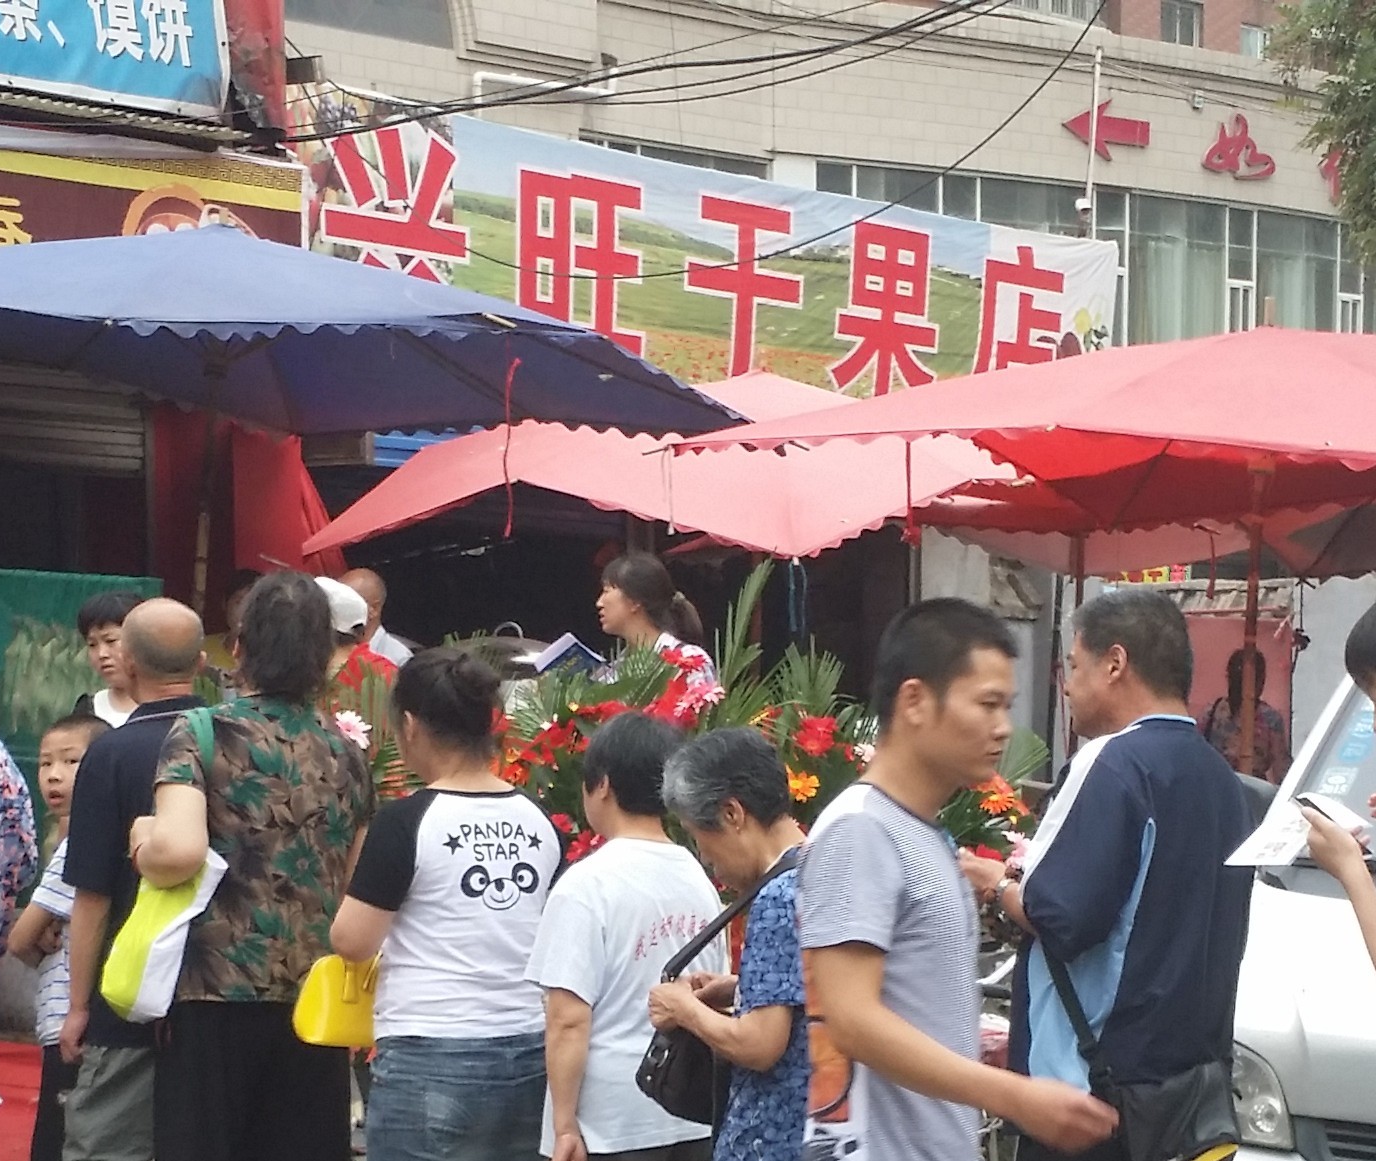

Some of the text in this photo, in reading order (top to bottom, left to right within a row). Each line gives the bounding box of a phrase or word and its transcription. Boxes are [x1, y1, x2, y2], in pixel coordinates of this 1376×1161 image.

[321, 122, 1065, 396] 兴旺干果店
[459, 821, 526, 843] PANDA
[474, 842, 520, 863] STAR
